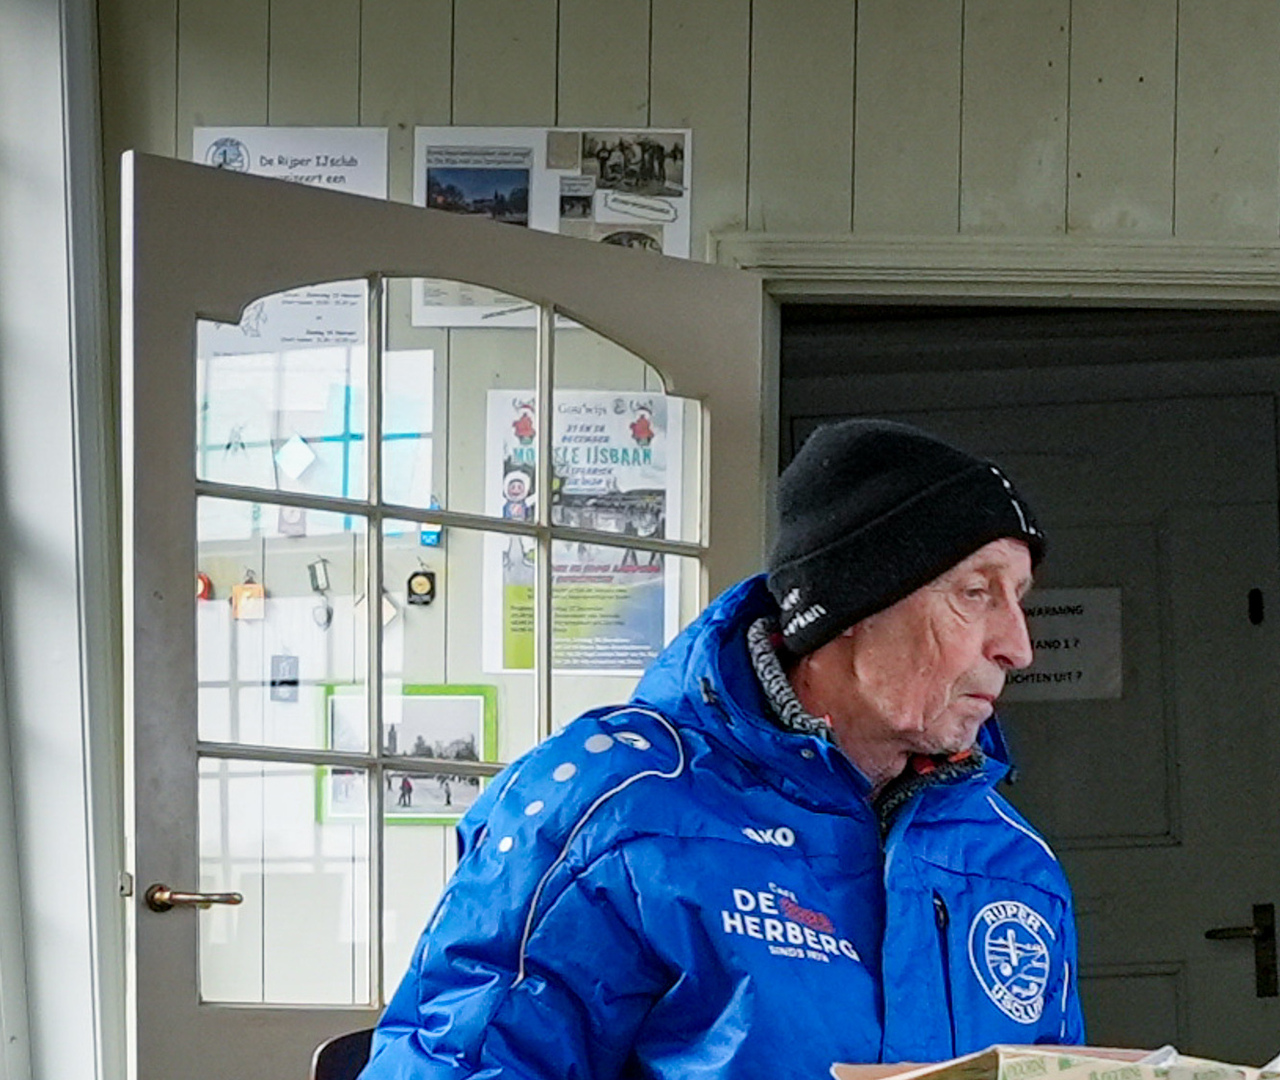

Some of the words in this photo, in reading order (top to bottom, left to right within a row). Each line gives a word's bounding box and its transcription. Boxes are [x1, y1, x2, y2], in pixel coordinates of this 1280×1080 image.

[259, 155, 274, 167] De
[277, 154, 312, 169] Rijper
[586, 447, 653, 466] IJSBAAN
[732, 887, 780, 915] DE
[720, 910, 861, 962] HERBERG
